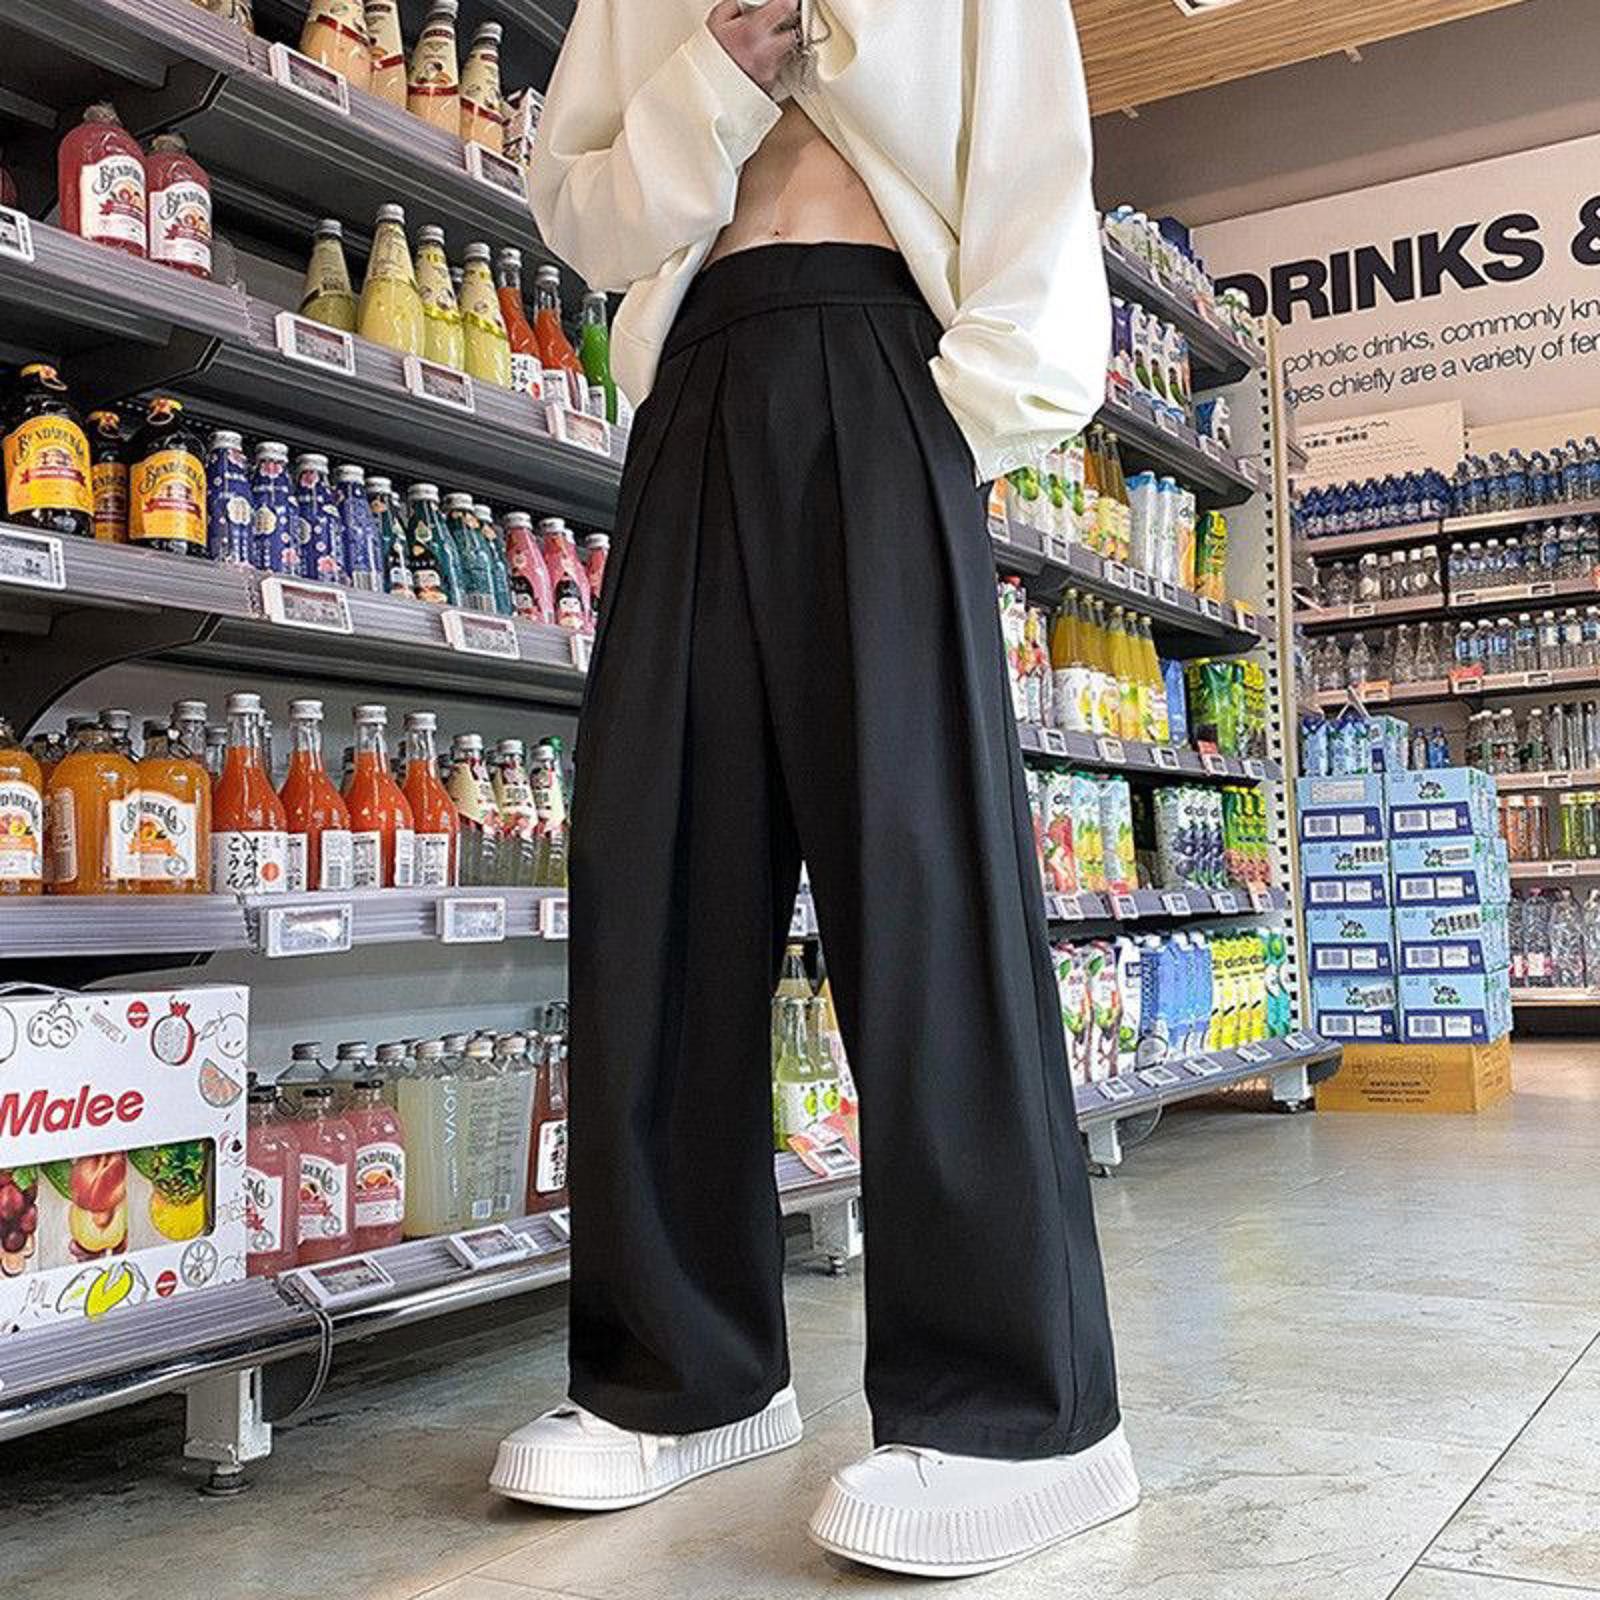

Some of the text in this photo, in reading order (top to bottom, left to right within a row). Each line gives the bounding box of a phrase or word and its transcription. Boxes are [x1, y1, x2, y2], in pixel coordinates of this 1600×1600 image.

[1214, 213, 1545, 326] DRINKS
[1363, 330, 1436, 358] drinks,
[1441, 304, 1565, 345] commonly
[1329, 367, 1394, 395] chiefly
[1400, 363, 1437, 386] are
[1441, 359, 1457, 378] a
[1462, 345, 1536, 373] variety
[1541, 335, 1563, 361] of
[0, 1084, 145, 1137] Malee
